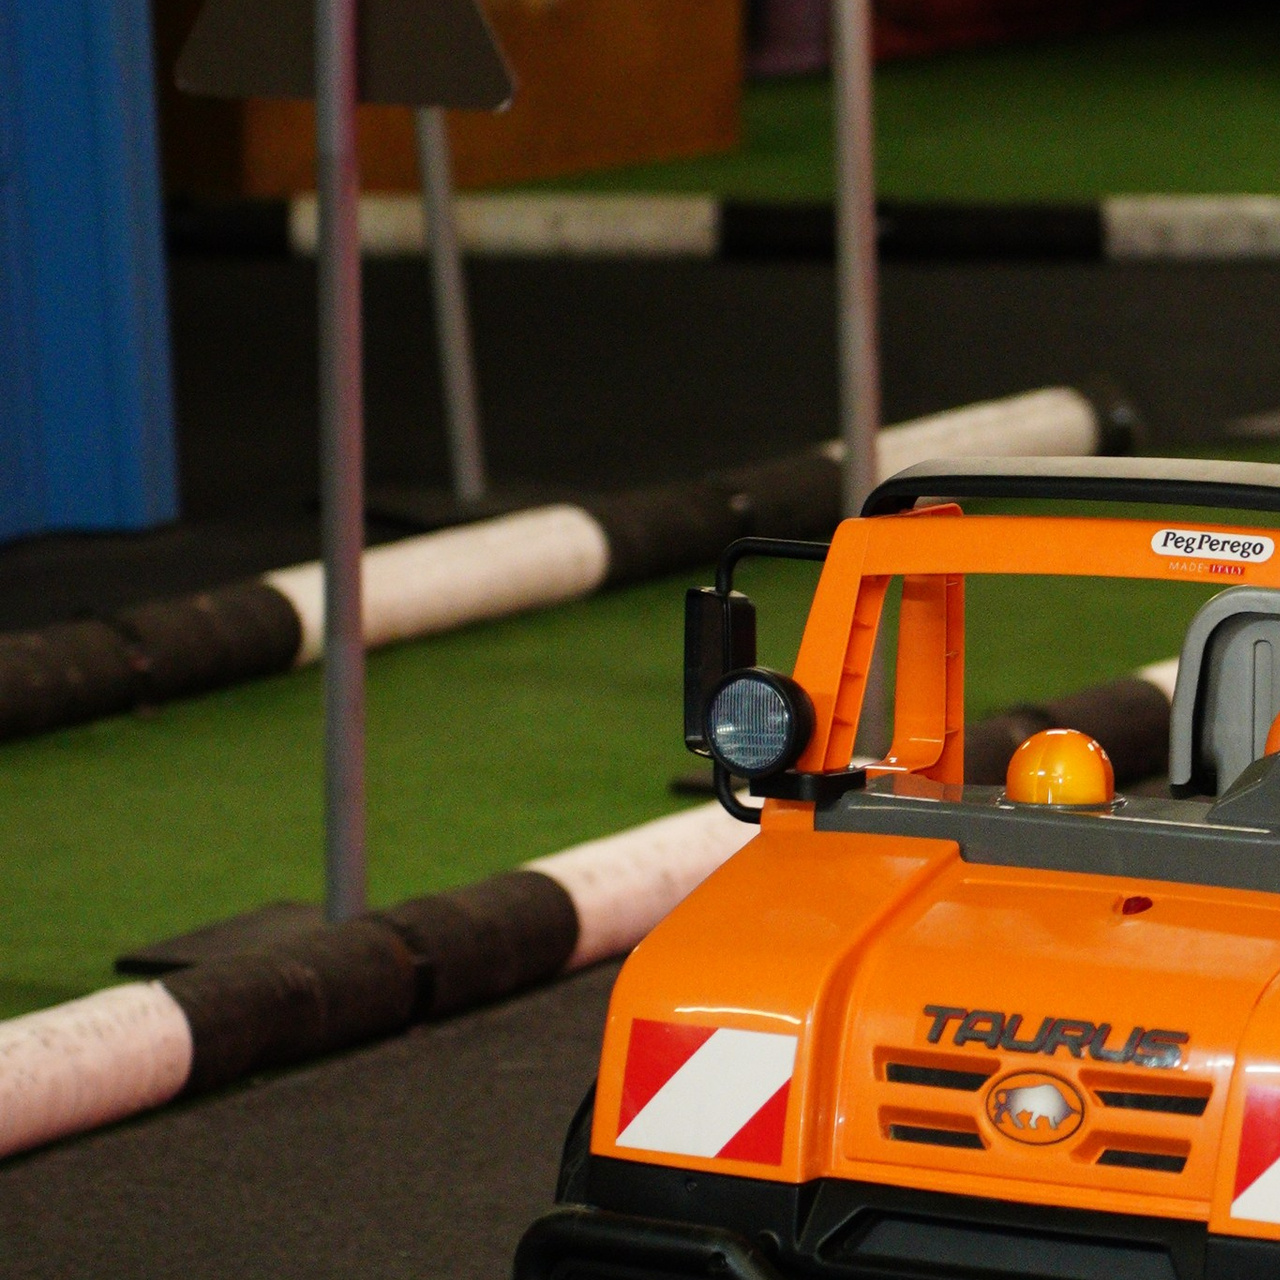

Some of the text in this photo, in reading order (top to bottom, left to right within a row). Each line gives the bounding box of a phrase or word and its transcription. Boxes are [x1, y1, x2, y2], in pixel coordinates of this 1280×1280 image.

[1169, 561, 1204, 573] MADE
[1211, 564, 1245, 576] ITALY
[924, 1004, 1190, 1068] TAURUS
